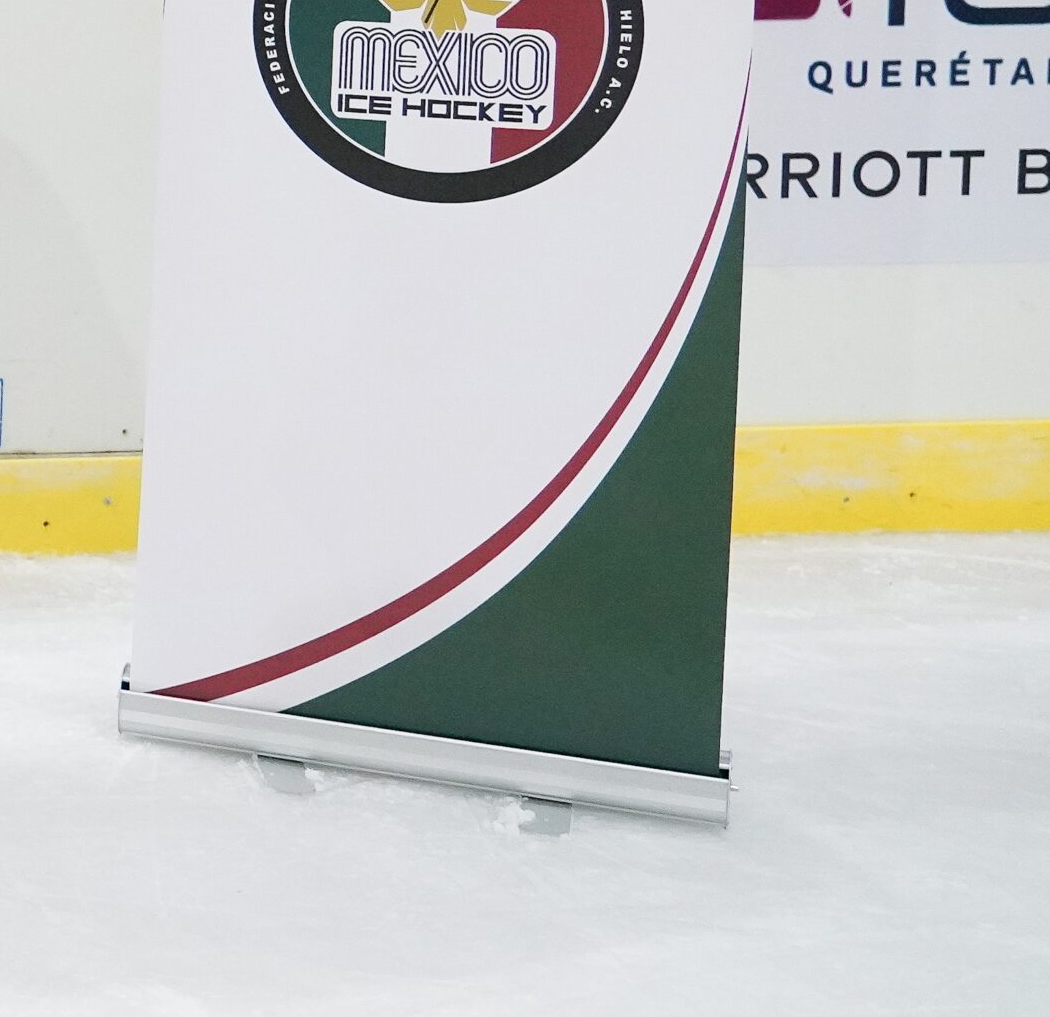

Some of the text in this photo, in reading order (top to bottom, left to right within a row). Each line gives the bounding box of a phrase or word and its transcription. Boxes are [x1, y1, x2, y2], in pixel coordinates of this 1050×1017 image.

[616, 9, 633, 70] HIELO
[338, 26, 550, 101] MEXICO
[807, 50, 1050, 94] QUERÉTA
[337, 93, 548, 125] ICE HOCKEY
[594, 76, 623, 115] A.C.
